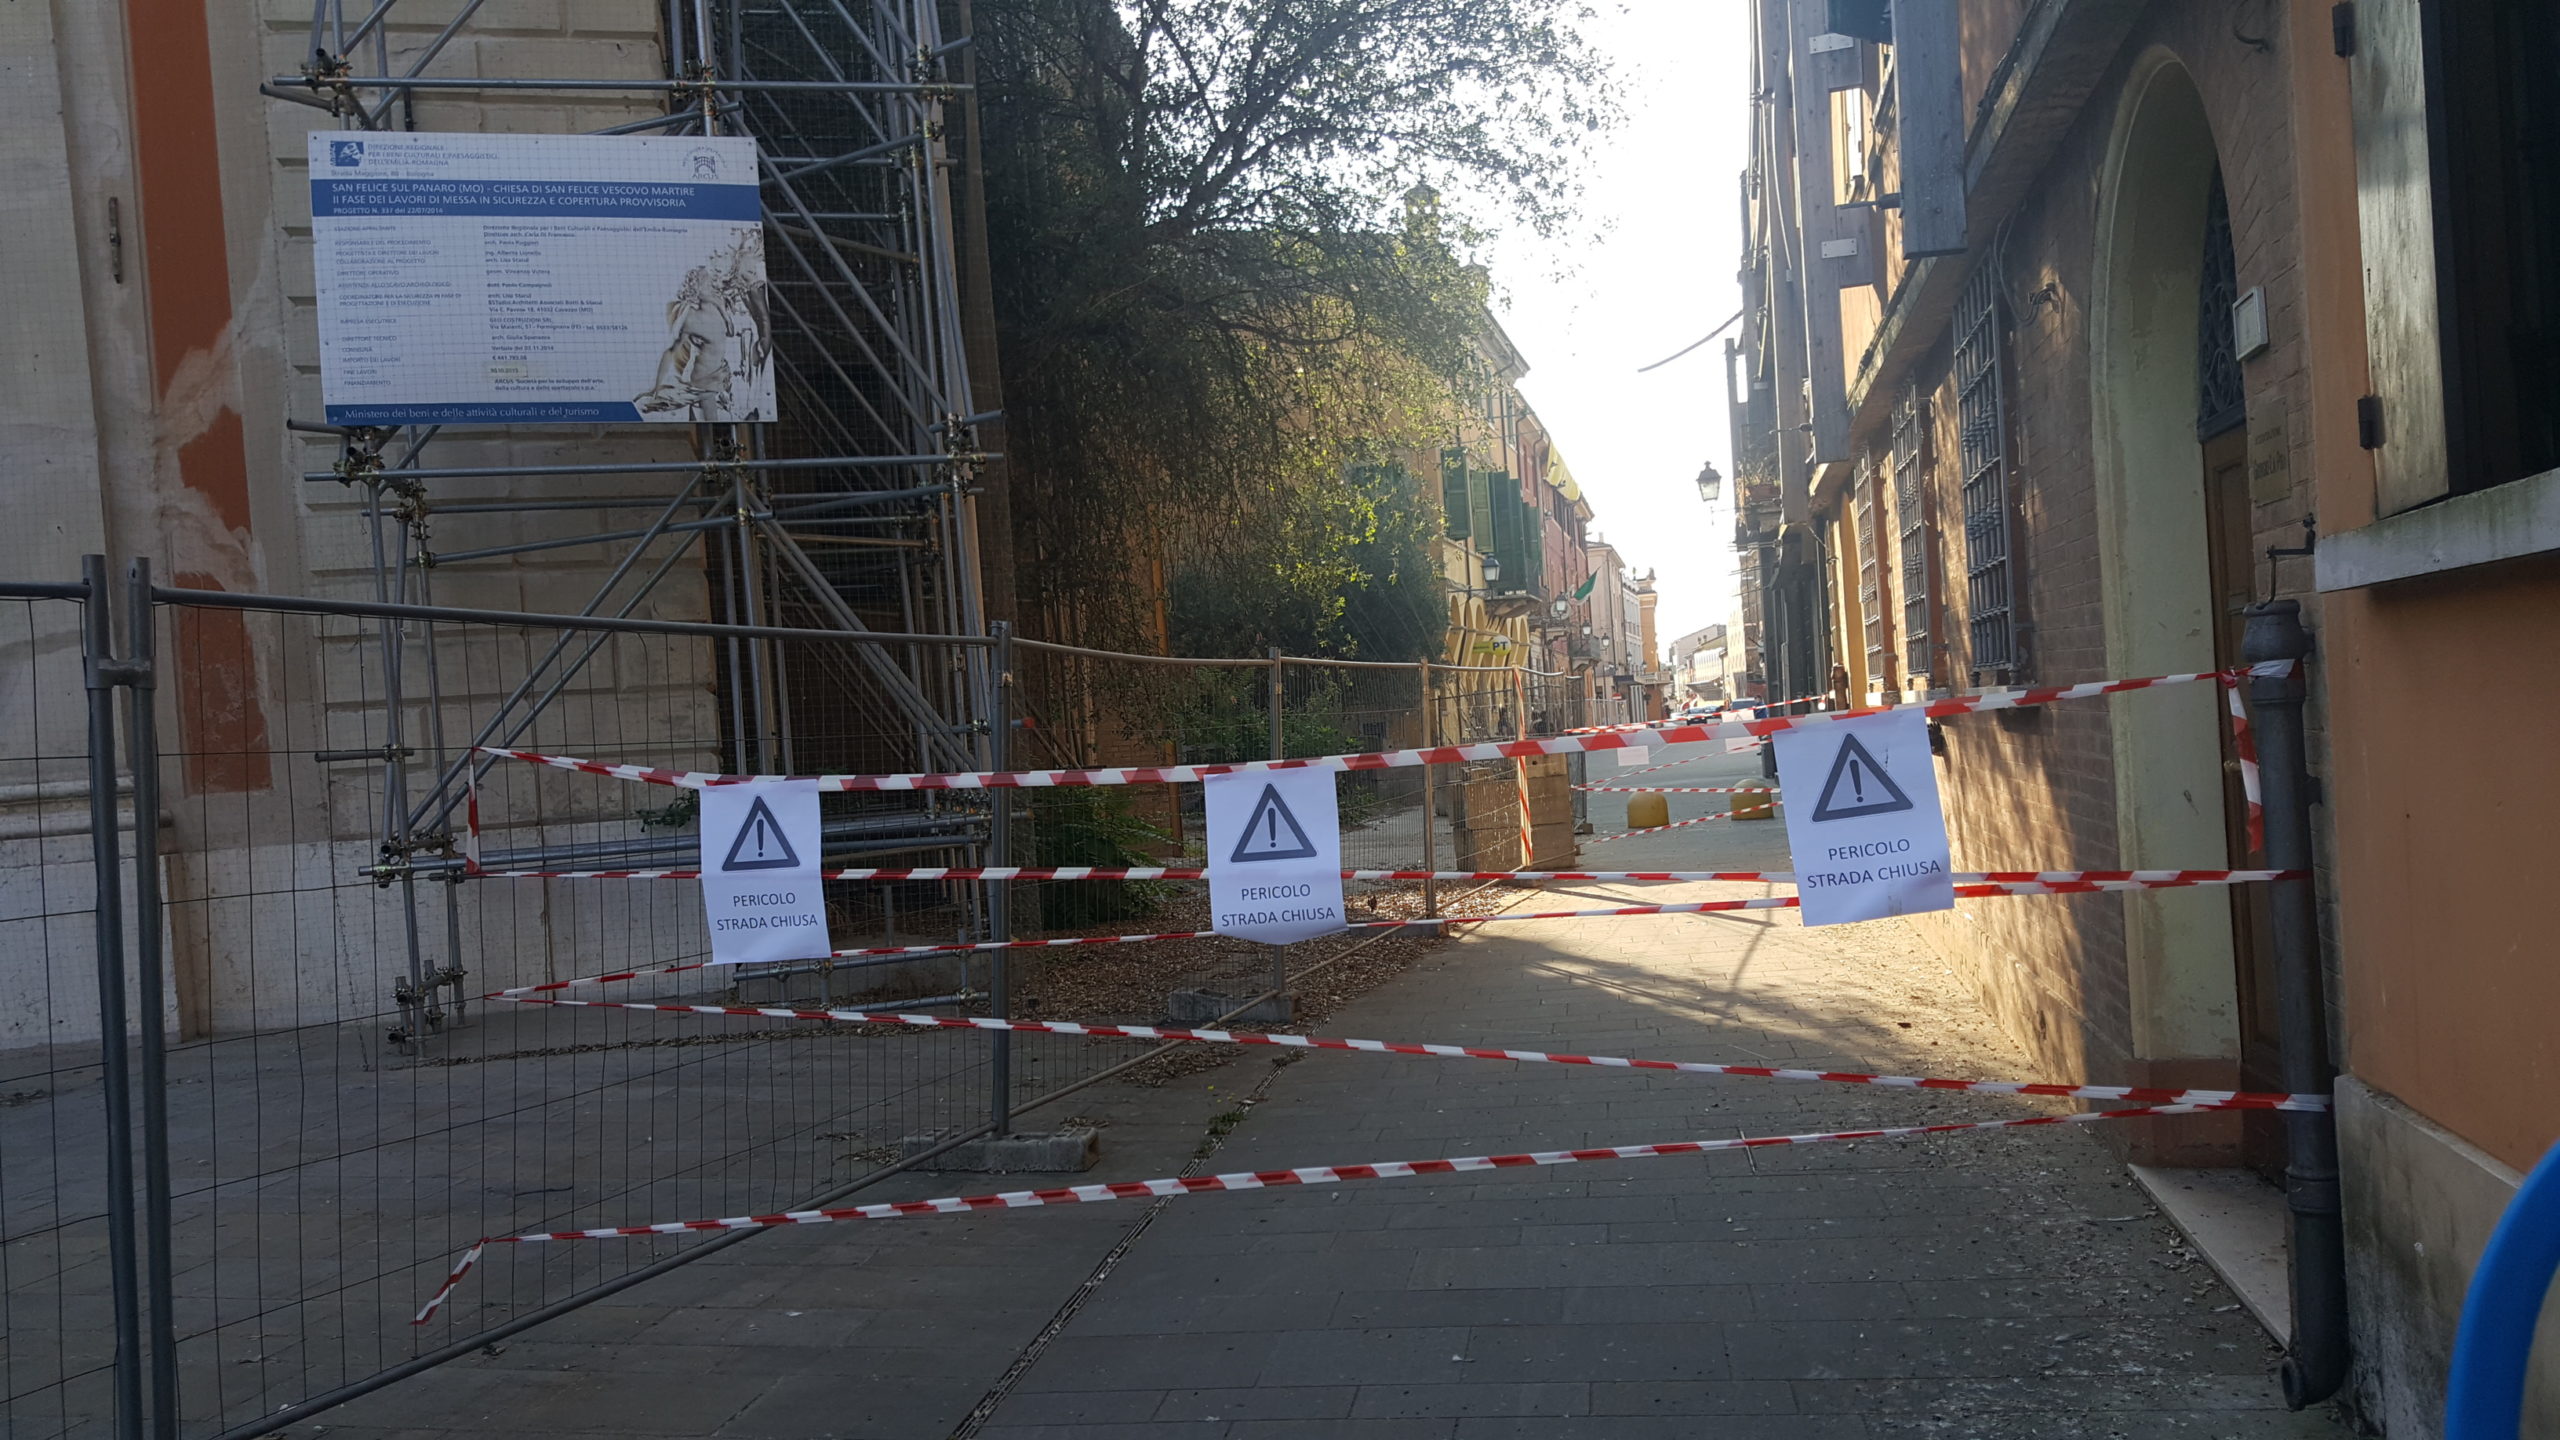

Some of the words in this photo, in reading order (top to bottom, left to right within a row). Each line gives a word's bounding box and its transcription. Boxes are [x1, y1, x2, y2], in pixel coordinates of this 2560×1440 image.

[332, 183, 353, 192] SAN
[357, 183, 389, 192] FELICE
[391, 183, 411, 192] SUL
[413, 184, 456, 192] PANARO
[459, 184, 484, 193] (MO)
[493, 184, 530, 193] CHIESA
[532, 185, 542, 193] DI
[545, 185, 565, 194] SAN
[569, 185, 599, 194] FELICE
[602, 186, 649, 195] VESCOVO
[652, 186, 695, 196] MARTIRE
[333, 195, 339, 204] II
[342, 195, 366, 204] FASE
[369, 195, 386, 204] DEI
[389, 195, 426, 204] LAVORI
[429, 195, 440, 204] DI
[443, 195, 477, 204] MESSA
[480, 196, 490, 204] IN
[493, 196, 547, 205] SICUREZZA
[550, 197, 556, 205] E
[558, 197, 617, 206] COPERTURA
[620, 198, 687, 207] PROVVISORIA
[345, 409, 389, 418] Ministero
[392, 408, 406, 417] dei
[409, 408, 430, 417] beni
[441, 408, 464, 417] delle
[466, 408, 497, 417] attività
[500, 407, 538, 416] culturali
[548, 407, 562, 416] del
[564, 407, 599, 416] turismo
[1493, 642, 1508, 651] PT
[1828, 838, 1910, 861] PERICOLO
[1807, 869, 1874, 889] STRADA
[1878, 860, 1941, 881] CHIUSA
[733, 891, 796, 907] PERICOLO
[1241, 883, 1310, 901] PERICOLO
[717, 916, 767, 931] STRADA
[770, 914, 818, 929] CHIUSA
[1221, 911, 1278, 928] STRADA
[1281, 906, 1335, 923] CHIUSA
